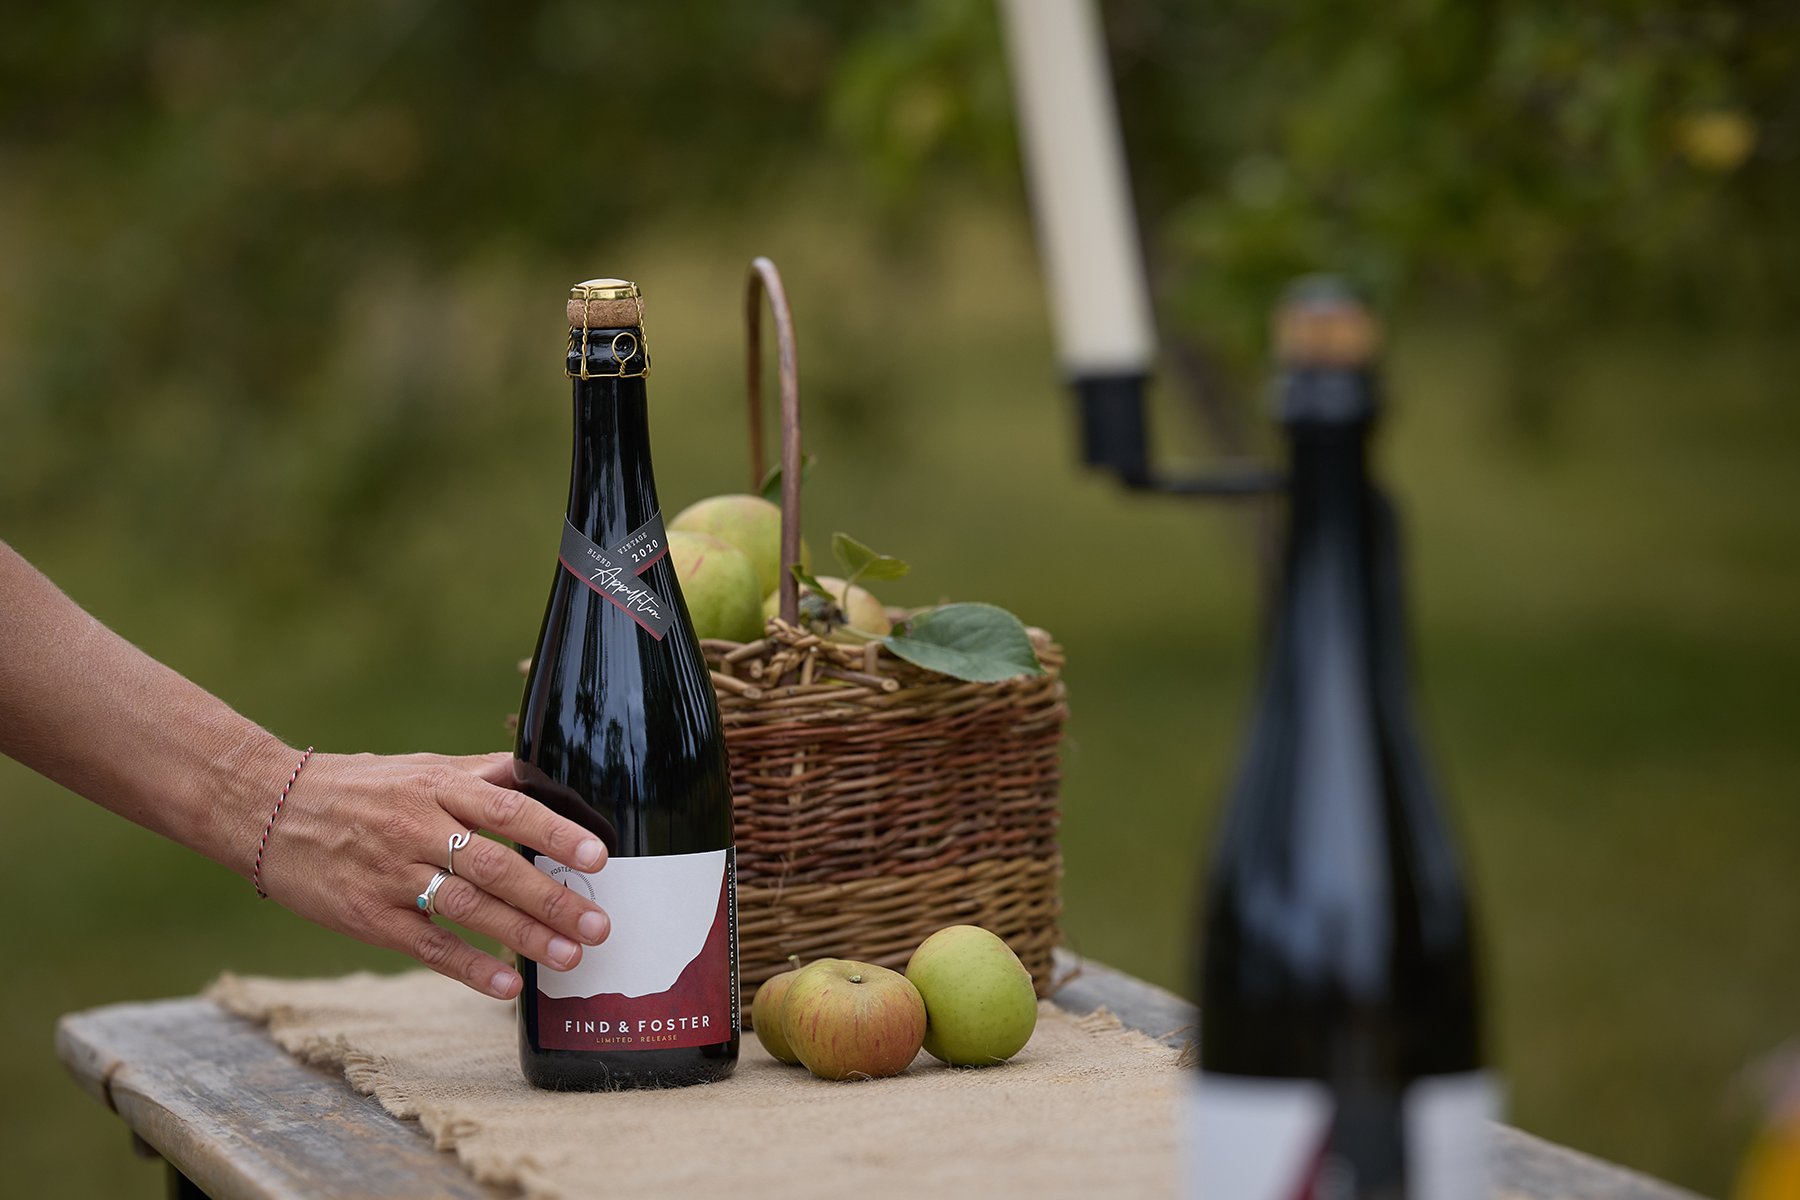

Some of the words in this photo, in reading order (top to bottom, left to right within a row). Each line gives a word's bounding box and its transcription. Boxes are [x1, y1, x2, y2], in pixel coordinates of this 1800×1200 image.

[617, 532, 648, 554] VINTAGE
[632, 539, 659, 563] 2020
[587, 548, 612, 568] BLEND
[565, 1020, 610, 1033] FIND
[618, 1021, 630, 1033] &
[638, 1015, 710, 1032] FOSTER
[596, 1036, 633, 1044] LIMITED
[640, 1034, 677, 1042] RELEASE
